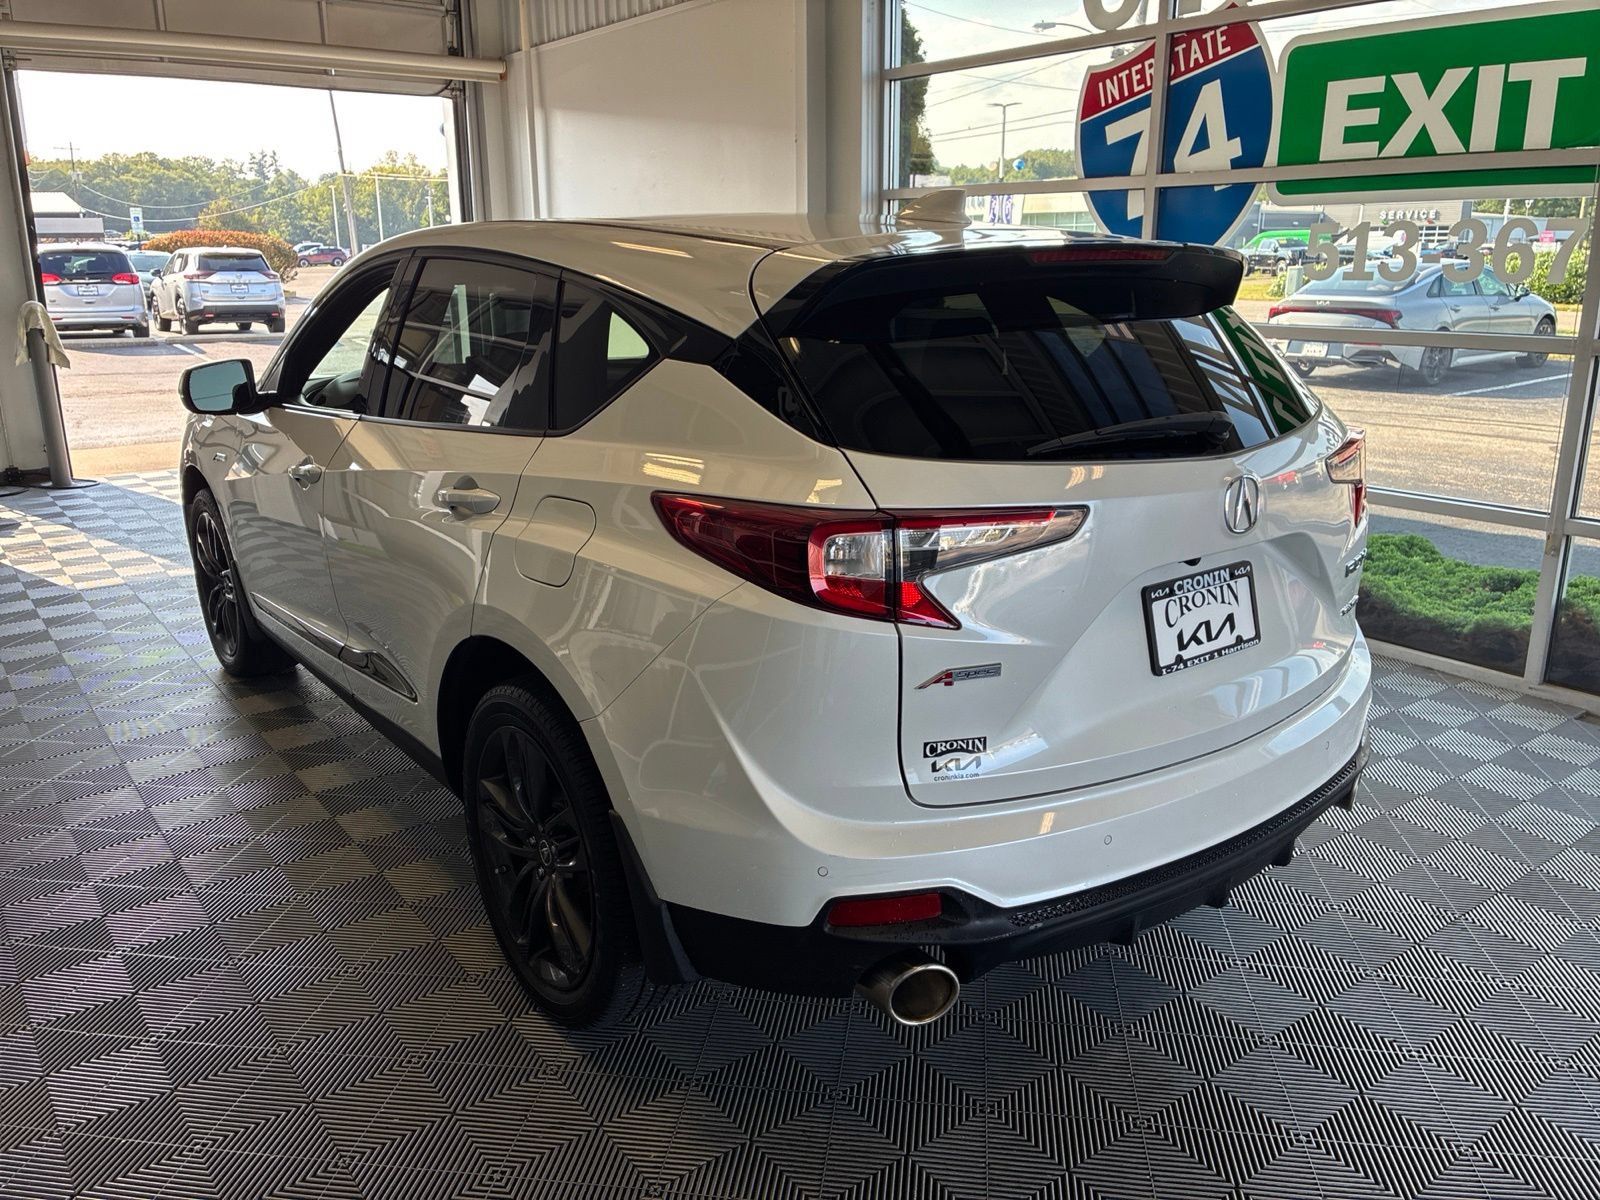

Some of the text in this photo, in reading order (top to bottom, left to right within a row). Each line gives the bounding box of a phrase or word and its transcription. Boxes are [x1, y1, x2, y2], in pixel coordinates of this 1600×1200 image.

[1098, 26, 1232, 108] INTERTATE
[1318, 57, 1588, 162] EXIT
[1104, 79, 1243, 221] 74
[1379, 208, 1437, 220] SERVICE
[1303, 217, 1590, 285] 513-367
[1173, 568, 1231, 595] CRONIN
[1164, 580, 1240, 628] CRONIN
[1176, 611, 1236, 652] KIA
[1161, 662, 1185, 675] I-74
[1187, 653, 1211, 667] EXIT
[1221, 639, 1260, 656] Harrison
[925, 738, 985, 757] CRONIN
[931, 756, 982, 773] KIA
[933, 772, 980, 781] croninkia.com
